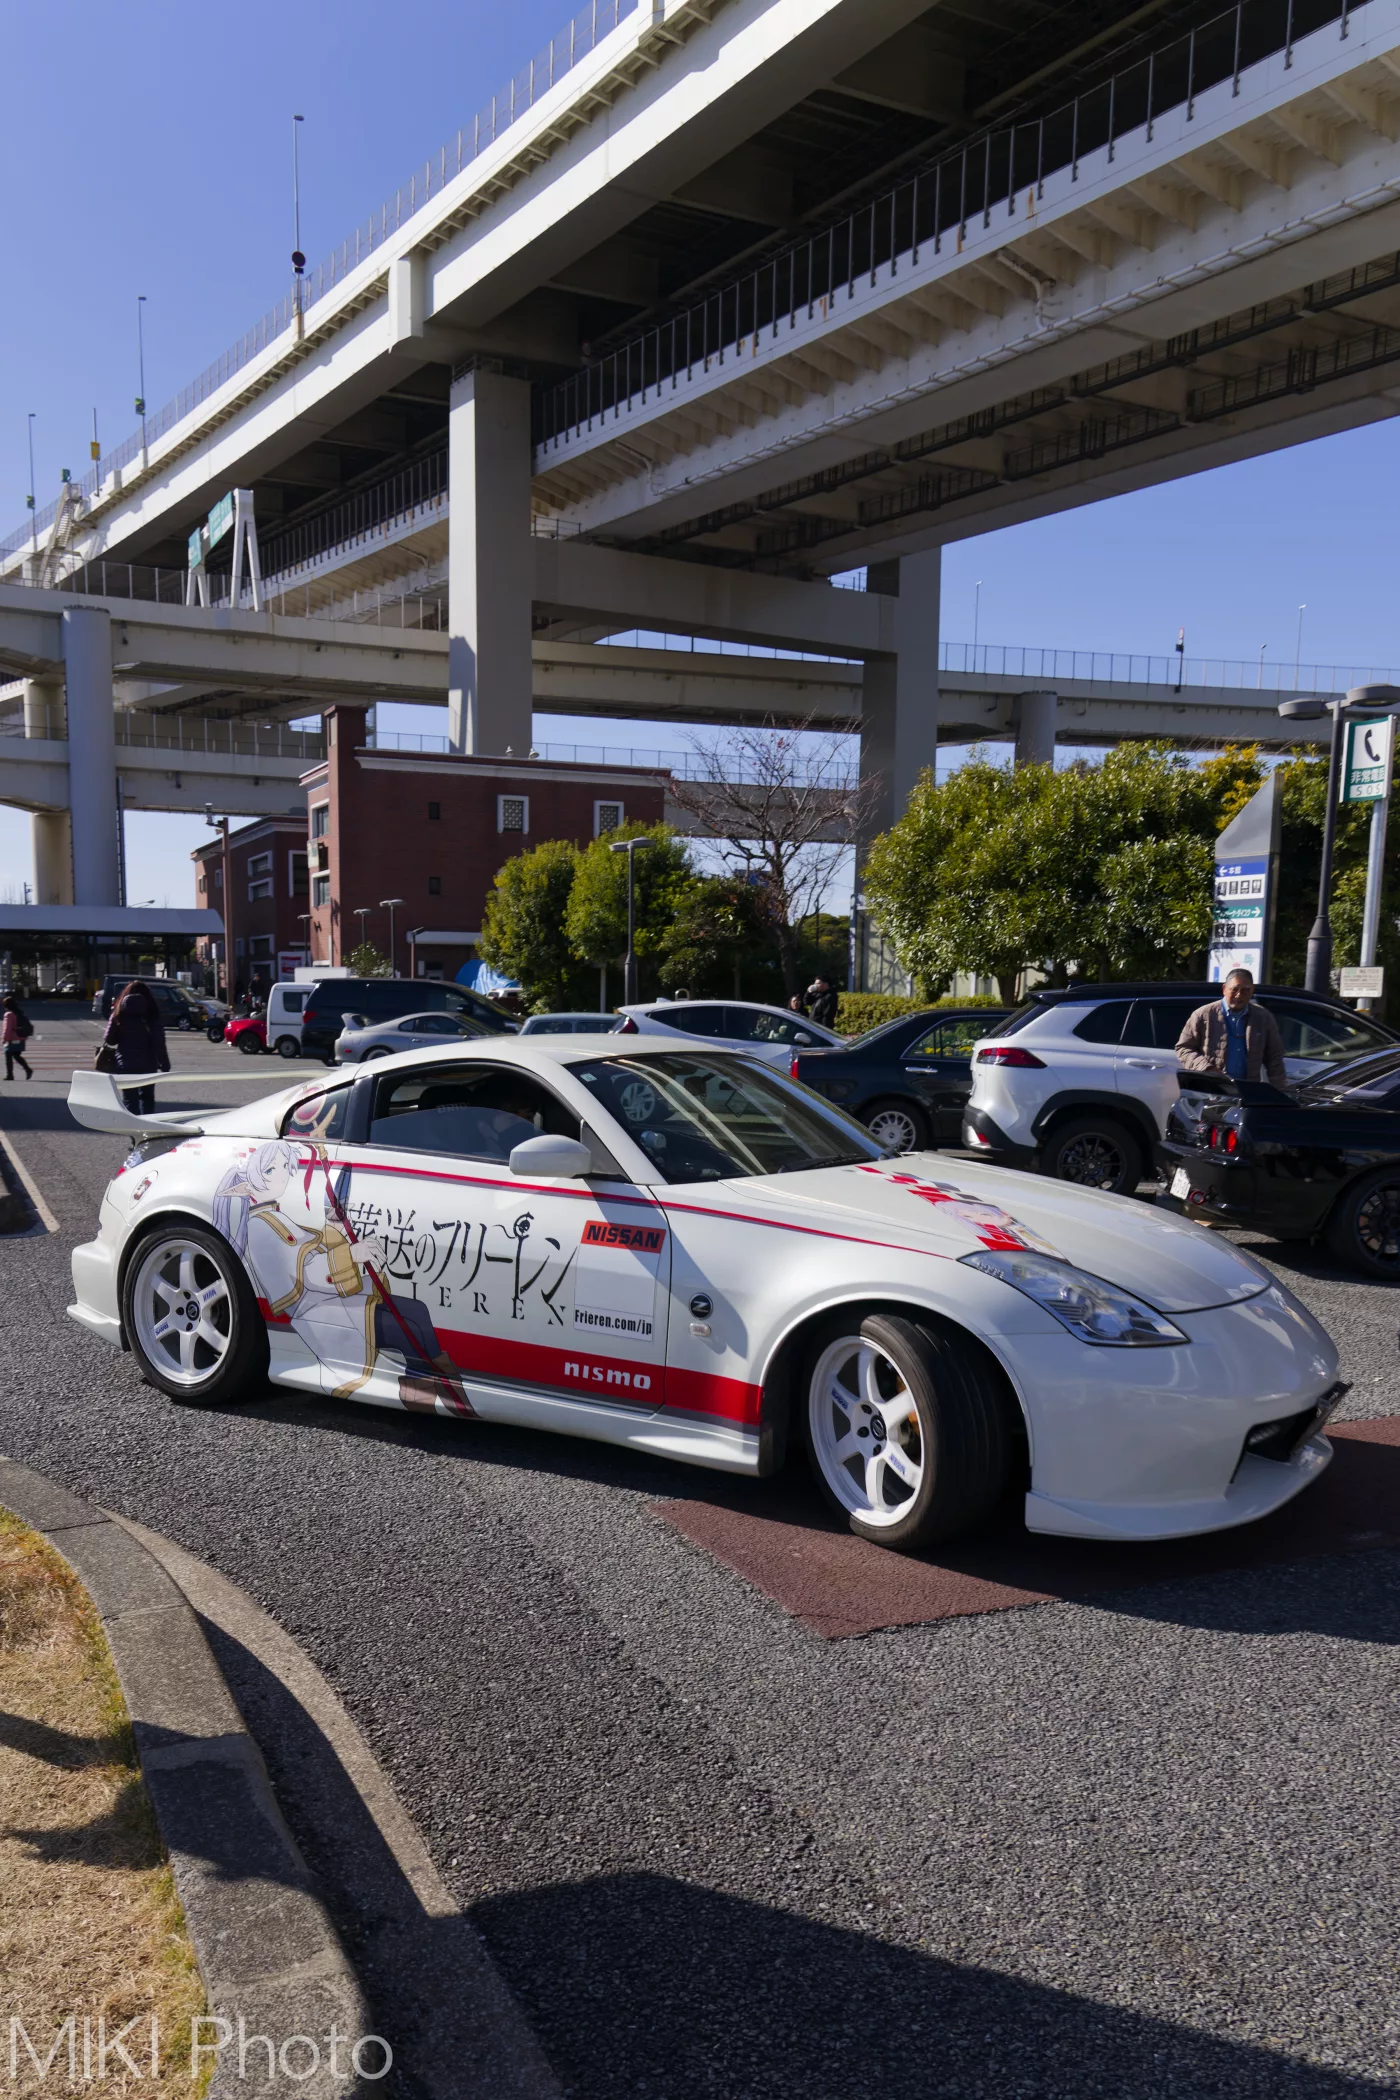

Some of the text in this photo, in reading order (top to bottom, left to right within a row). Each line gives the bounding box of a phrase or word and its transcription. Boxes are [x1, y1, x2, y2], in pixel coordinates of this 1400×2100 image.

[1356, 783, 1381, 796] SOS
[586, 1225, 661, 1249] NISSAN
[574, 1309, 652, 1335] Frieren.com/jp
[564, 1362, 652, 1390] nismo
